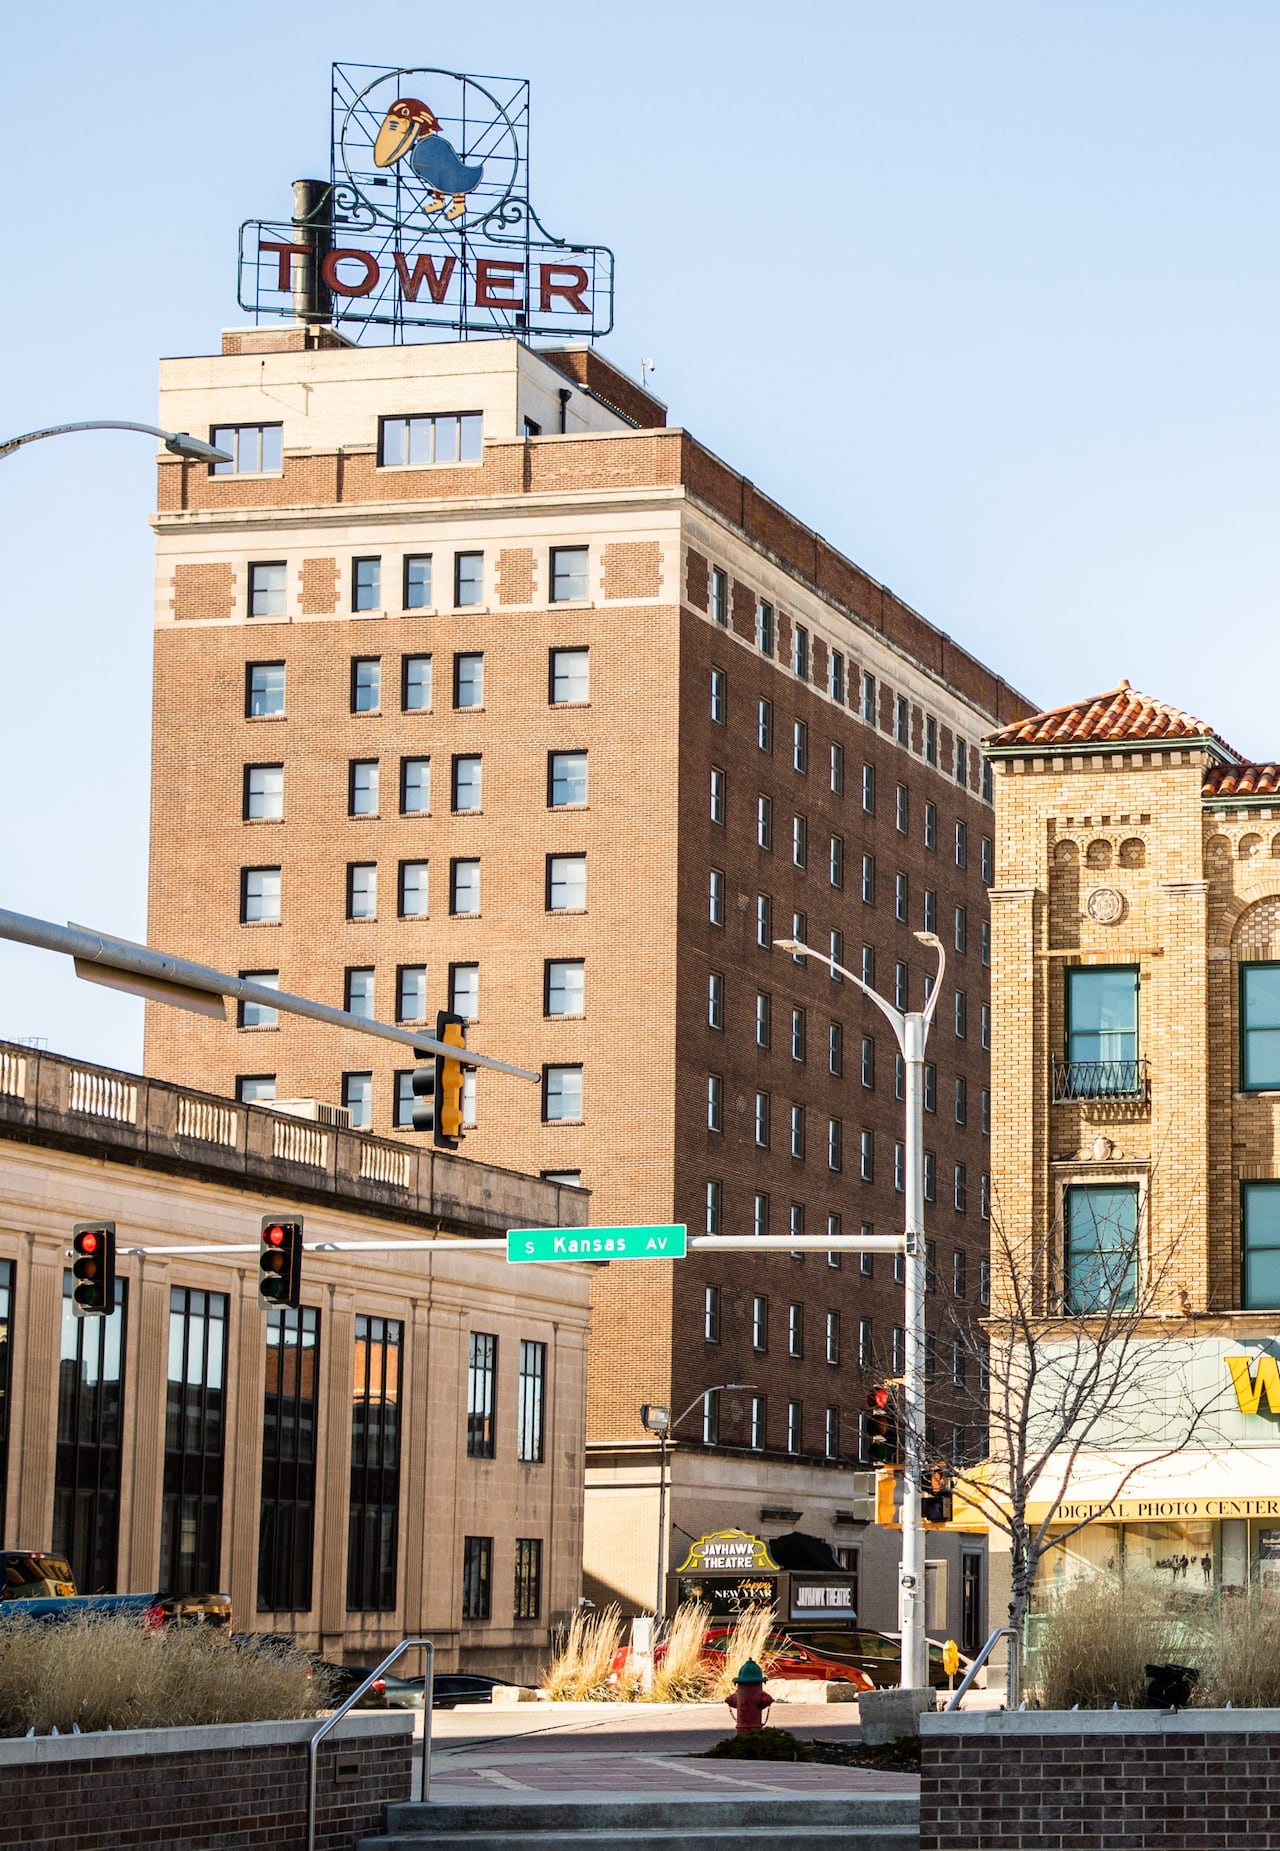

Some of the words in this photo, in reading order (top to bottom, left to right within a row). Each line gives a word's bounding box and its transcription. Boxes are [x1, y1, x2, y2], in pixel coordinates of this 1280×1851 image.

[258, 241, 593, 314] TOWER
[525, 1241, 535, 1255] S
[553, 1236, 626, 1254] Kansas
[646, 1237, 668, 1251] AV
[1058, 1504, 1130, 1519] DIGITAL
[1138, 1502, 1198, 1517] PHOTO
[1205, 1500, 1280, 1515] CENTER
[702, 1543, 755, 1555] JAYHAWK
[703, 1556, 753, 1568] THEATRE
[737, 1578, 773, 1592] Happy
[714, 1589, 740, 1599] NEW
[742, 1588, 772, 1598] YEAR
[797, 1587, 826, 1607] JAYHAWK
[826, 1587, 852, 1607] THEATRE
